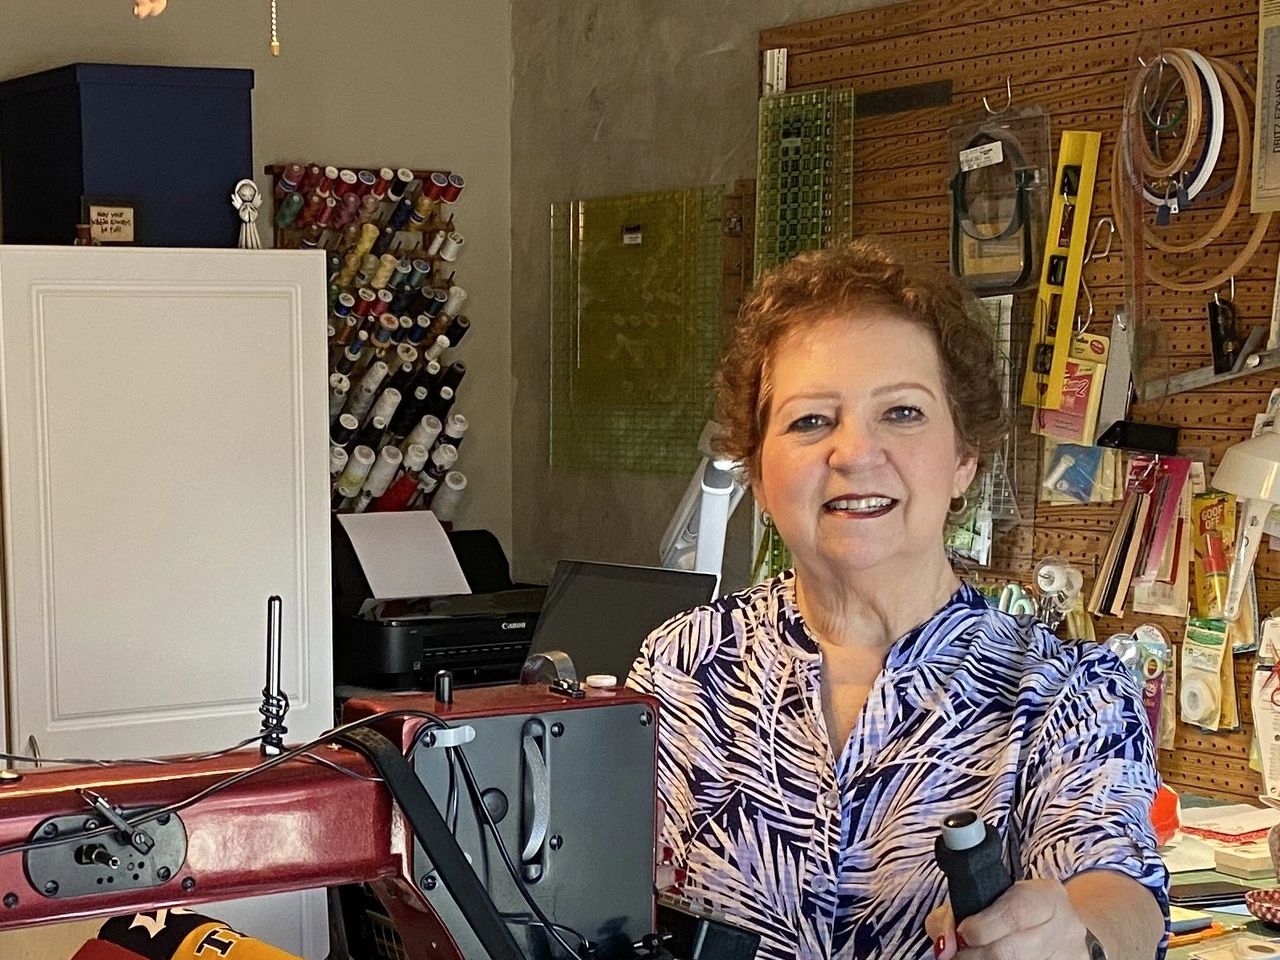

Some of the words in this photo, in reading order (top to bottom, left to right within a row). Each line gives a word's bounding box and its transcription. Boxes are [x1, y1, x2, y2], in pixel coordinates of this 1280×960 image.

[1201, 504, 1224, 521] GOOF
[1204, 516, 1221, 530] OFF
[501, 622, 526, 630] Canon
